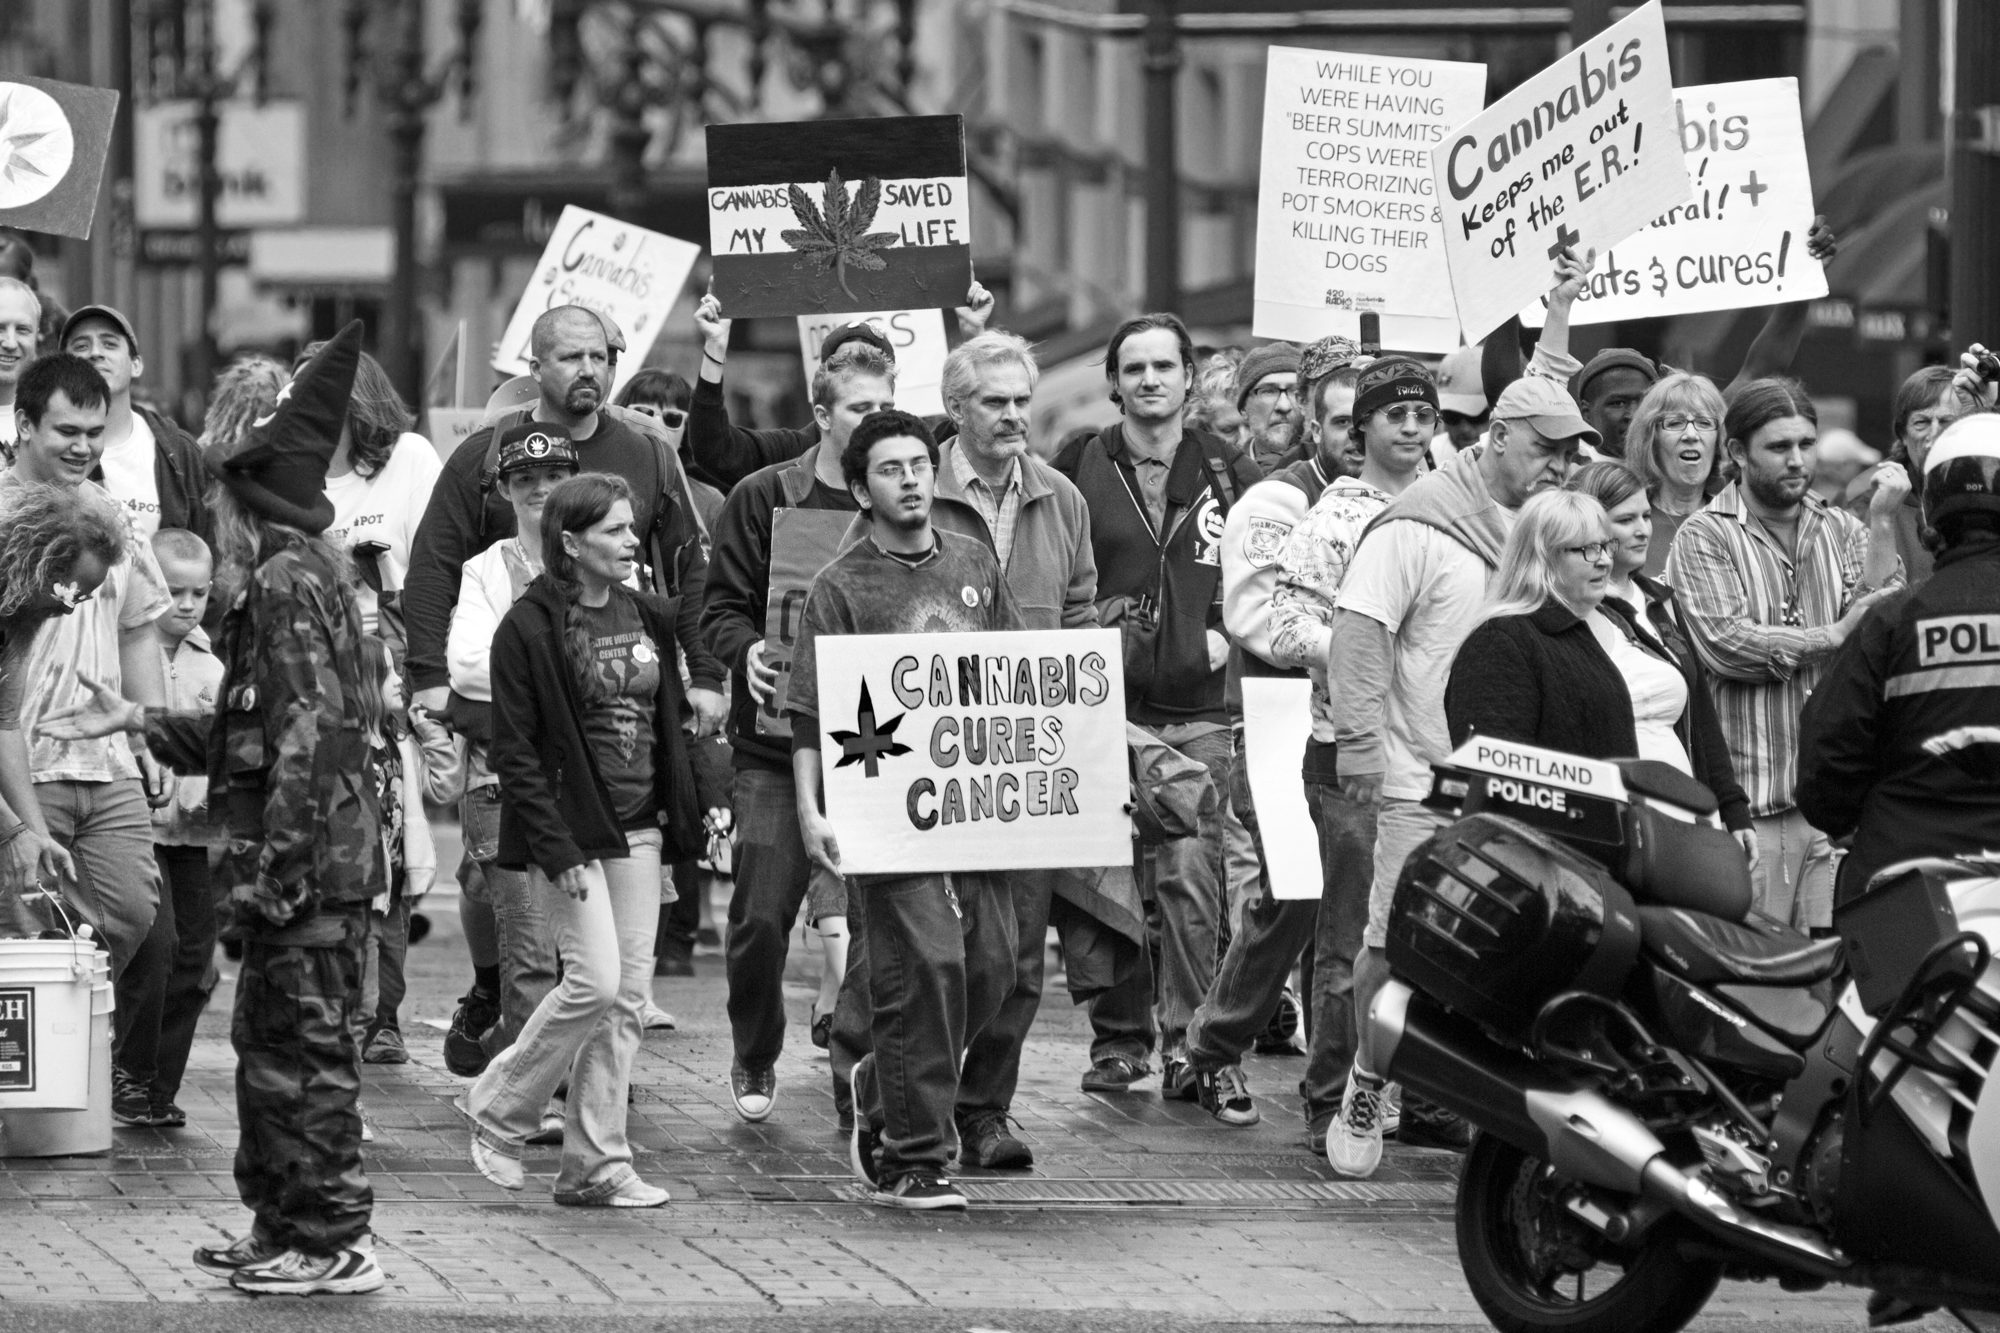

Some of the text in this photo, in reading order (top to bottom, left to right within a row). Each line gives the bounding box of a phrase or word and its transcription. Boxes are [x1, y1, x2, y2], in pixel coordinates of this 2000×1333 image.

[1316, 60, 1432, 88] WHILE YOU
[1301, 86, 1444, 116] WERE HAVING
[1286, 112, 1450, 143] "BEER SUMMITS"
[1448, 38, 1641, 201] Cannabis
[1306, 141, 1428, 169] COPS WERE
[1541, 144, 1575, 181] me
[1589, 98, 1630, 144] out
[711, 182, 952, 211] CANNABIS SAVED
[1297, 167, 1433, 196] TERRORIZING
[1282, 192, 1442, 223] POT SMOKERS &
[1637, 183, 1730, 232] ural!
[729, 219, 960, 253] MY LIFE
[1292, 220, 1429, 249] KILLING THEIR
[1490, 218, 1516, 258] of
[1526, 195, 1565, 232] the
[562, 218, 655, 299] Cannabis
[1325, 251, 1388, 274] DOGS
[1326, 288, 1345, 298] 420
[1966, 483, 1983, 491] DOT
[599, 647, 628, 660] CENTER
[1925, 622, 2000, 658] POL
[891, 652, 1109, 710] CANNABIS
[929, 715, 1065, 768] CURES
[1478, 746, 1593, 786] PORTLAND
[906, 767, 1079, 831] CANCER
[1486, 777, 1567, 813] POLICE
[0, 999, 25, 1020] H
